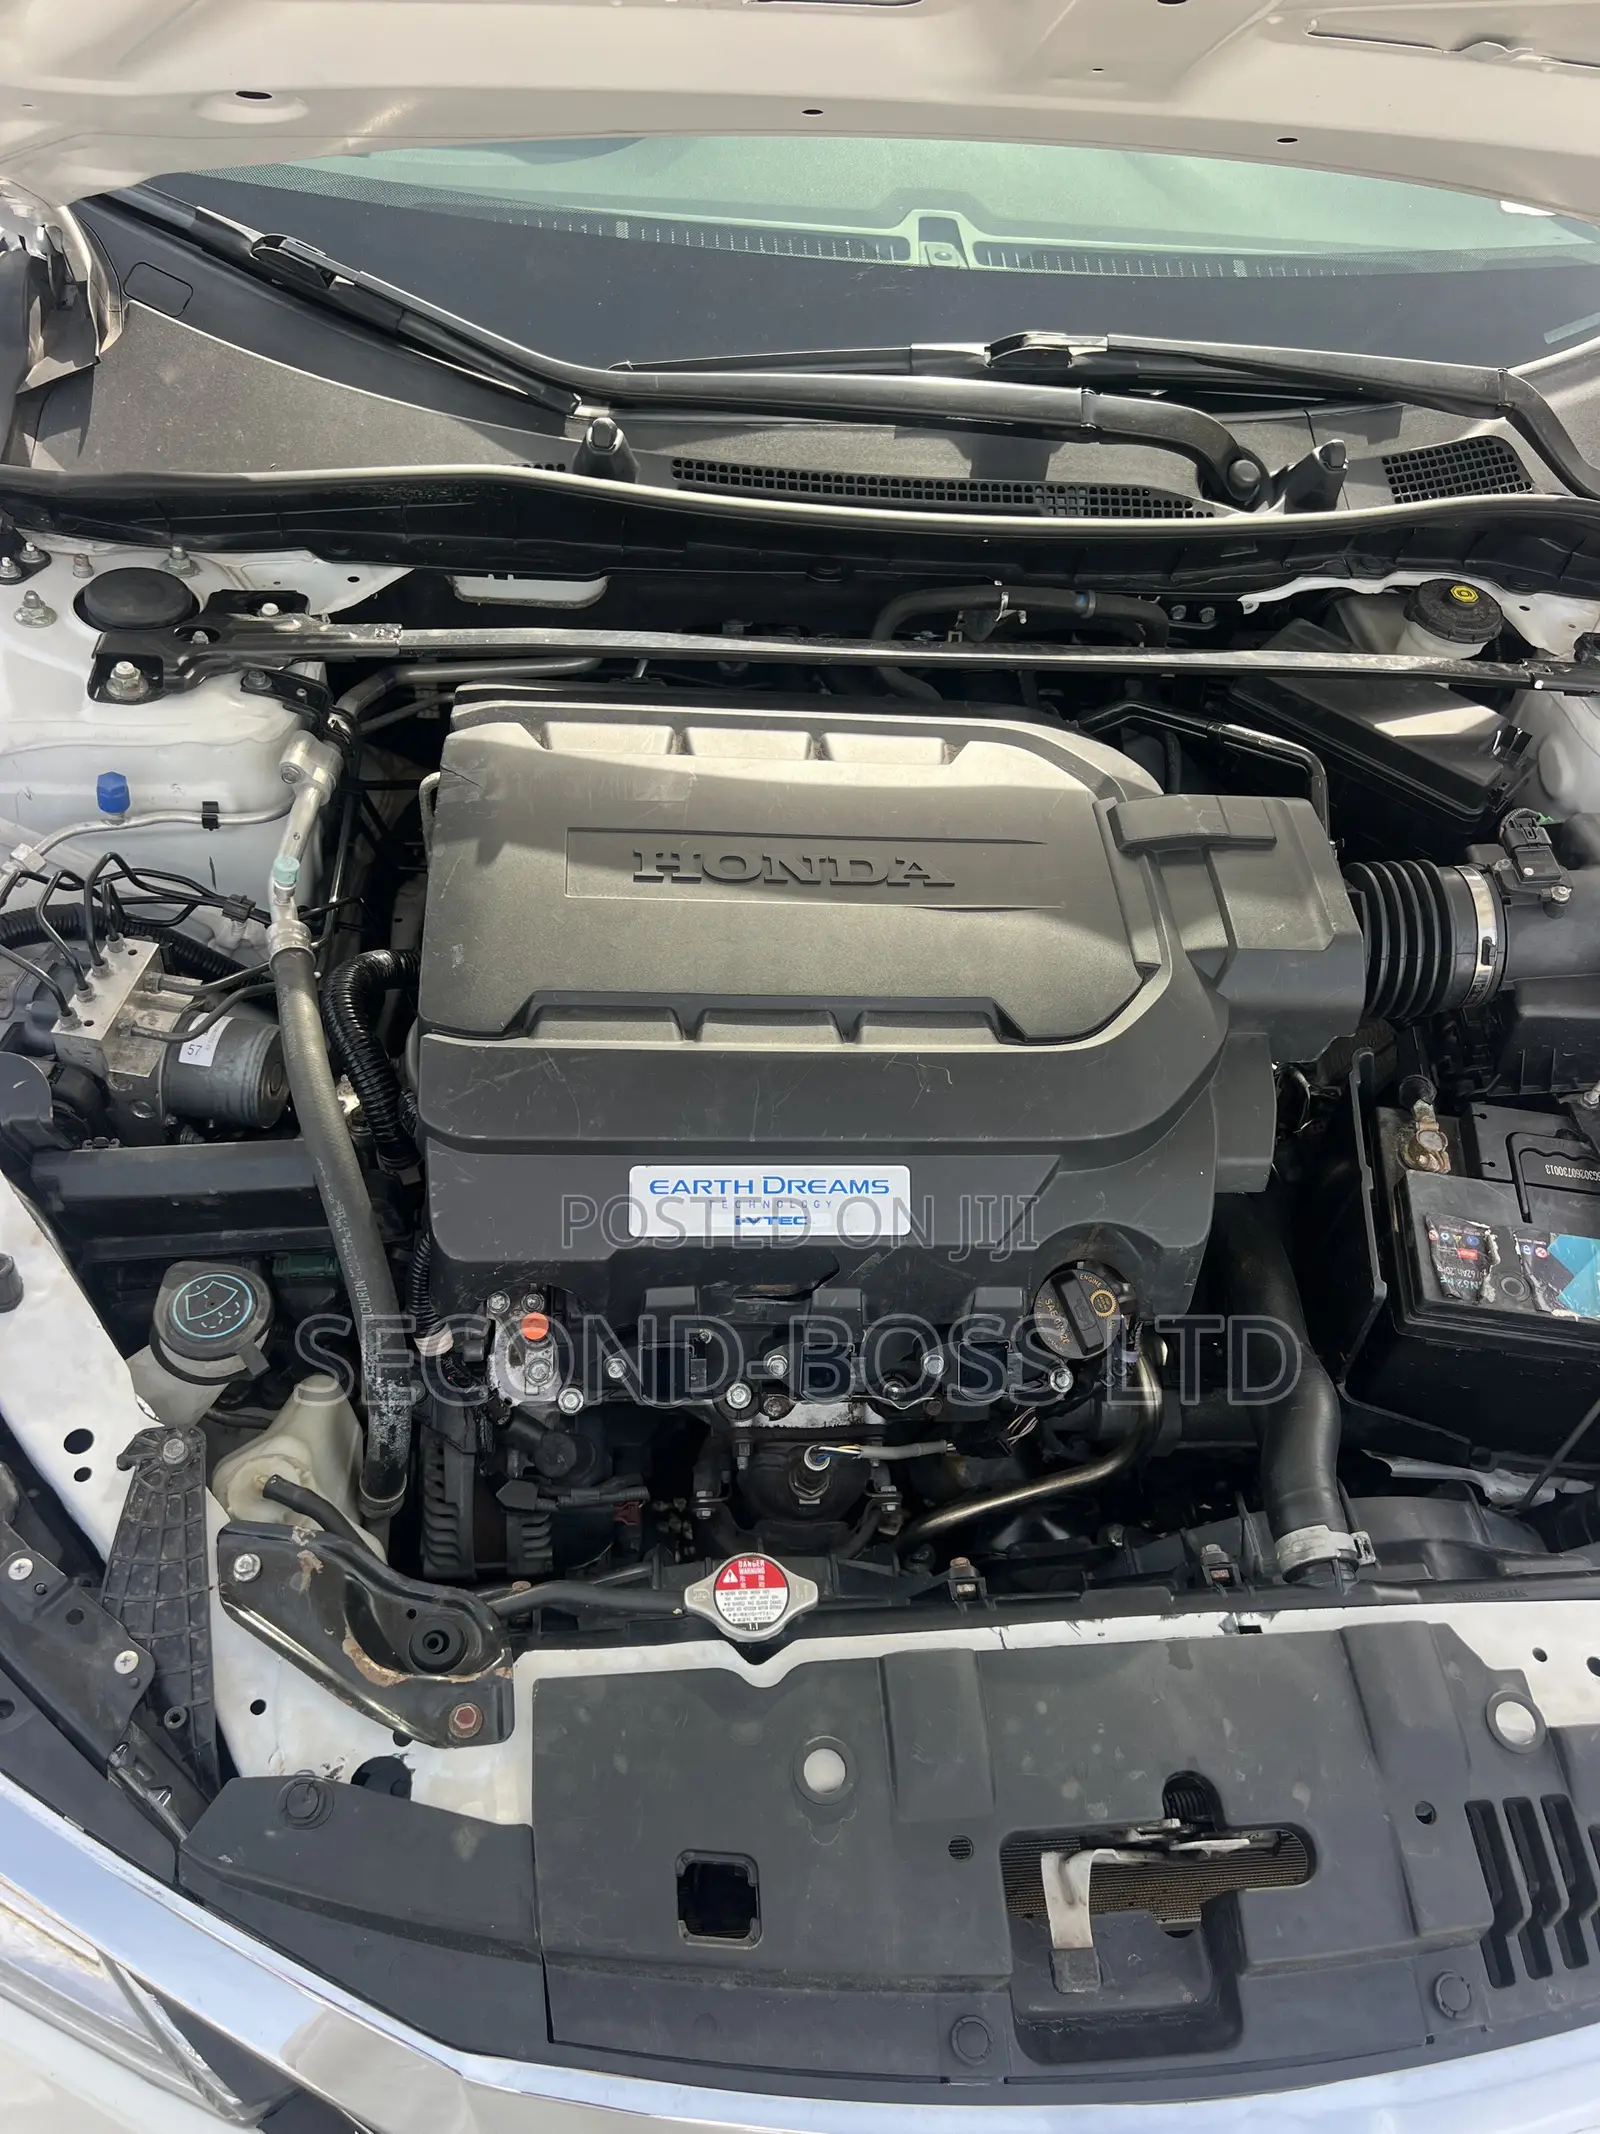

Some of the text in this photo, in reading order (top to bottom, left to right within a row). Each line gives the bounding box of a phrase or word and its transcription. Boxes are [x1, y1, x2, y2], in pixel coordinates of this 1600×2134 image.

[633, 850, 955, 887] HONDA
[187, 1044, 203, 1056] 57
[649, 1176, 890, 1195] EARTH DREAMS
[709, 1200, 833, 1209] TECHNOLOGY
[1080, 1273, 1103, 1289] ENGINE
[1045, 1298, 1059, 1318] SAE
[738, 1560, 765, 1568] DANGER
